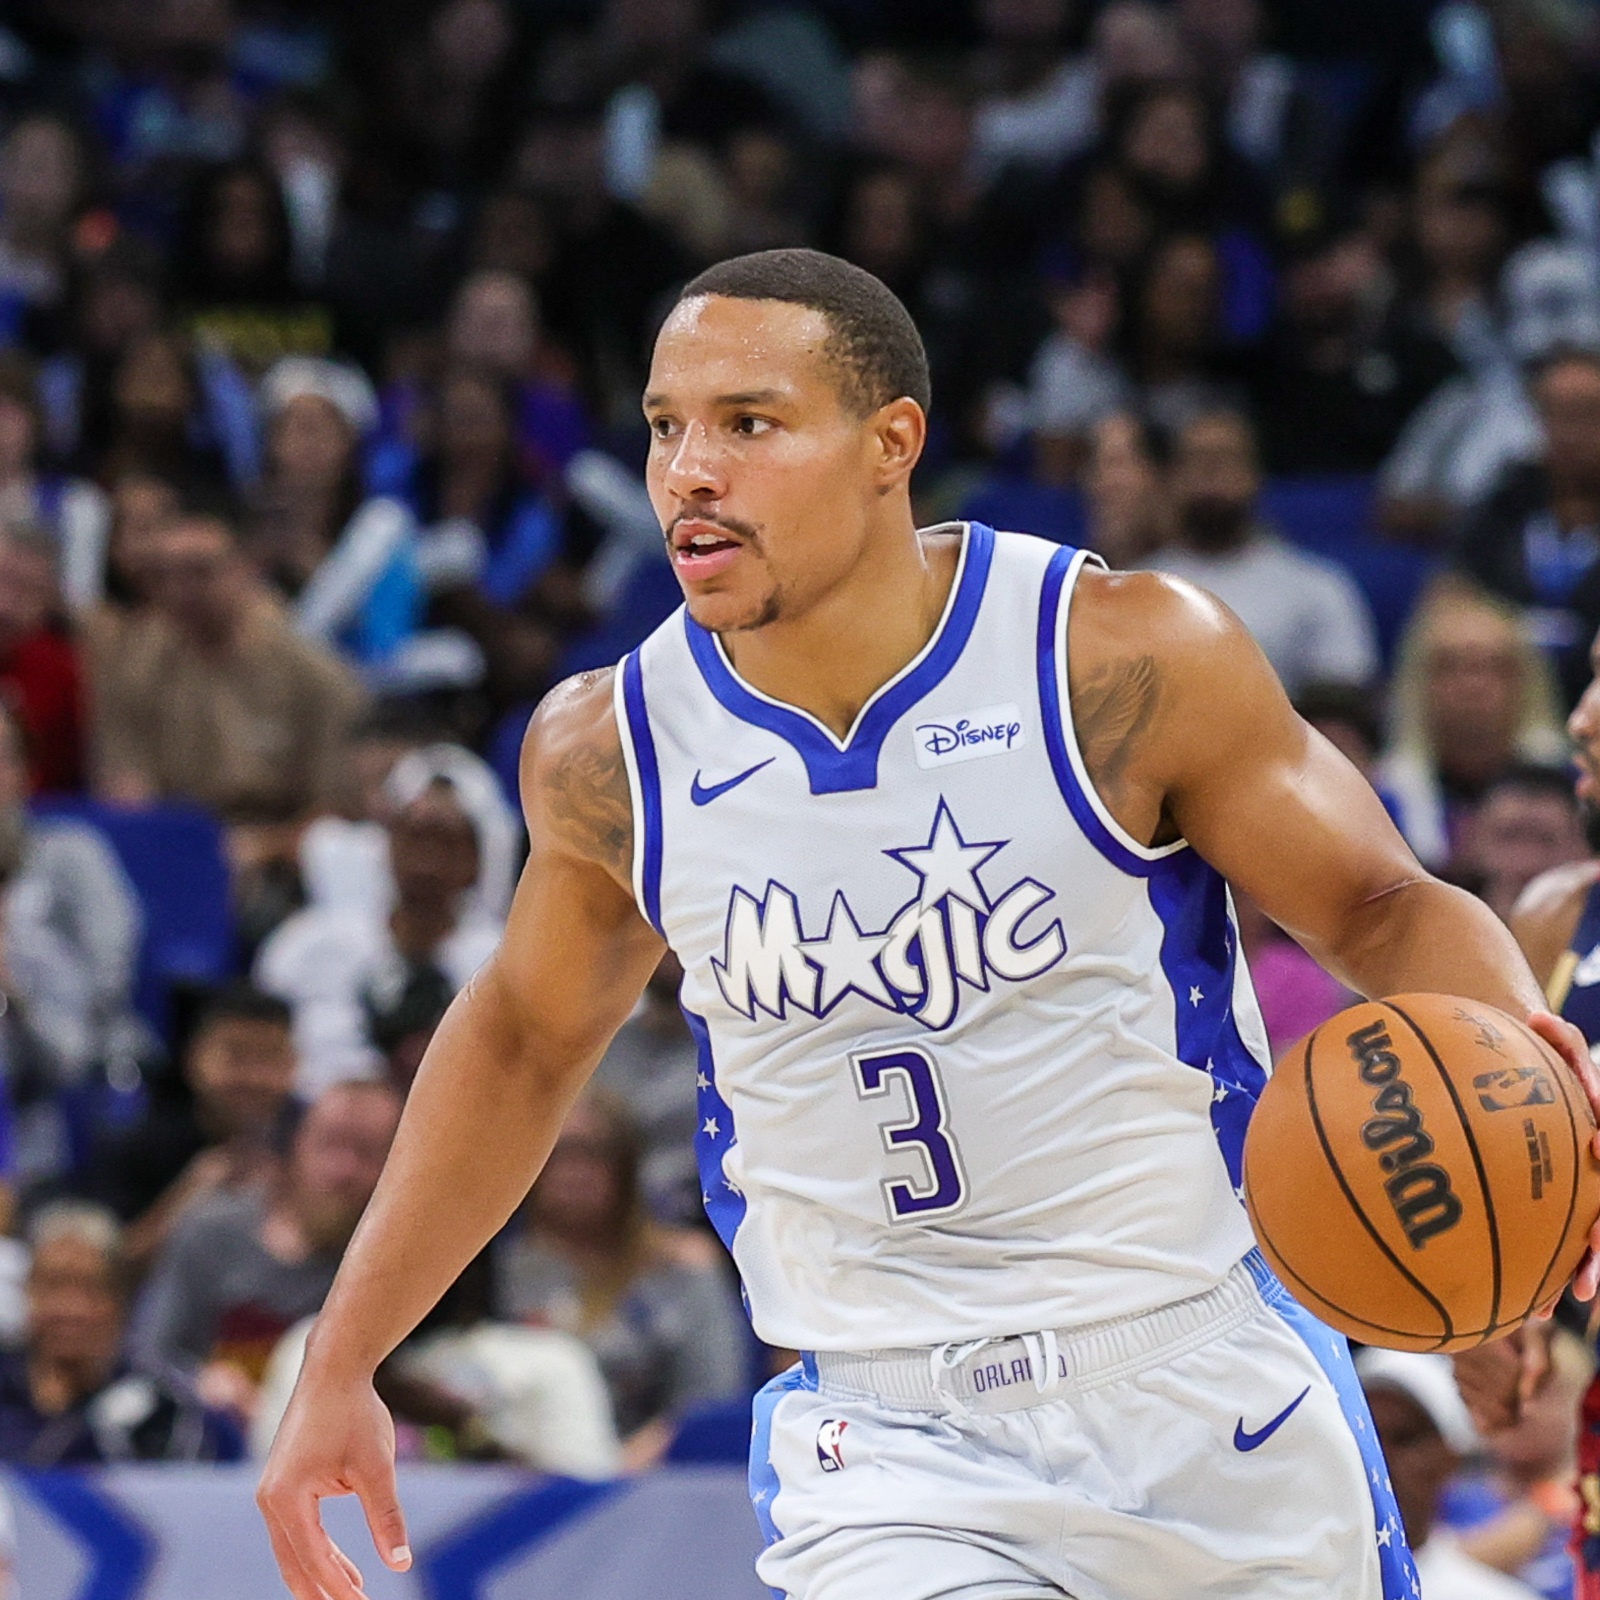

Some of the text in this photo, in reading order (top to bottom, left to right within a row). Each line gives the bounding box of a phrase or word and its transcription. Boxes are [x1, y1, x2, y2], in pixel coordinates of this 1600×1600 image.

[849, 1042, 971, 1226] 3
[1345, 1018, 1464, 1251] Wilson
[972, 1353, 1069, 1394] ORLAO
